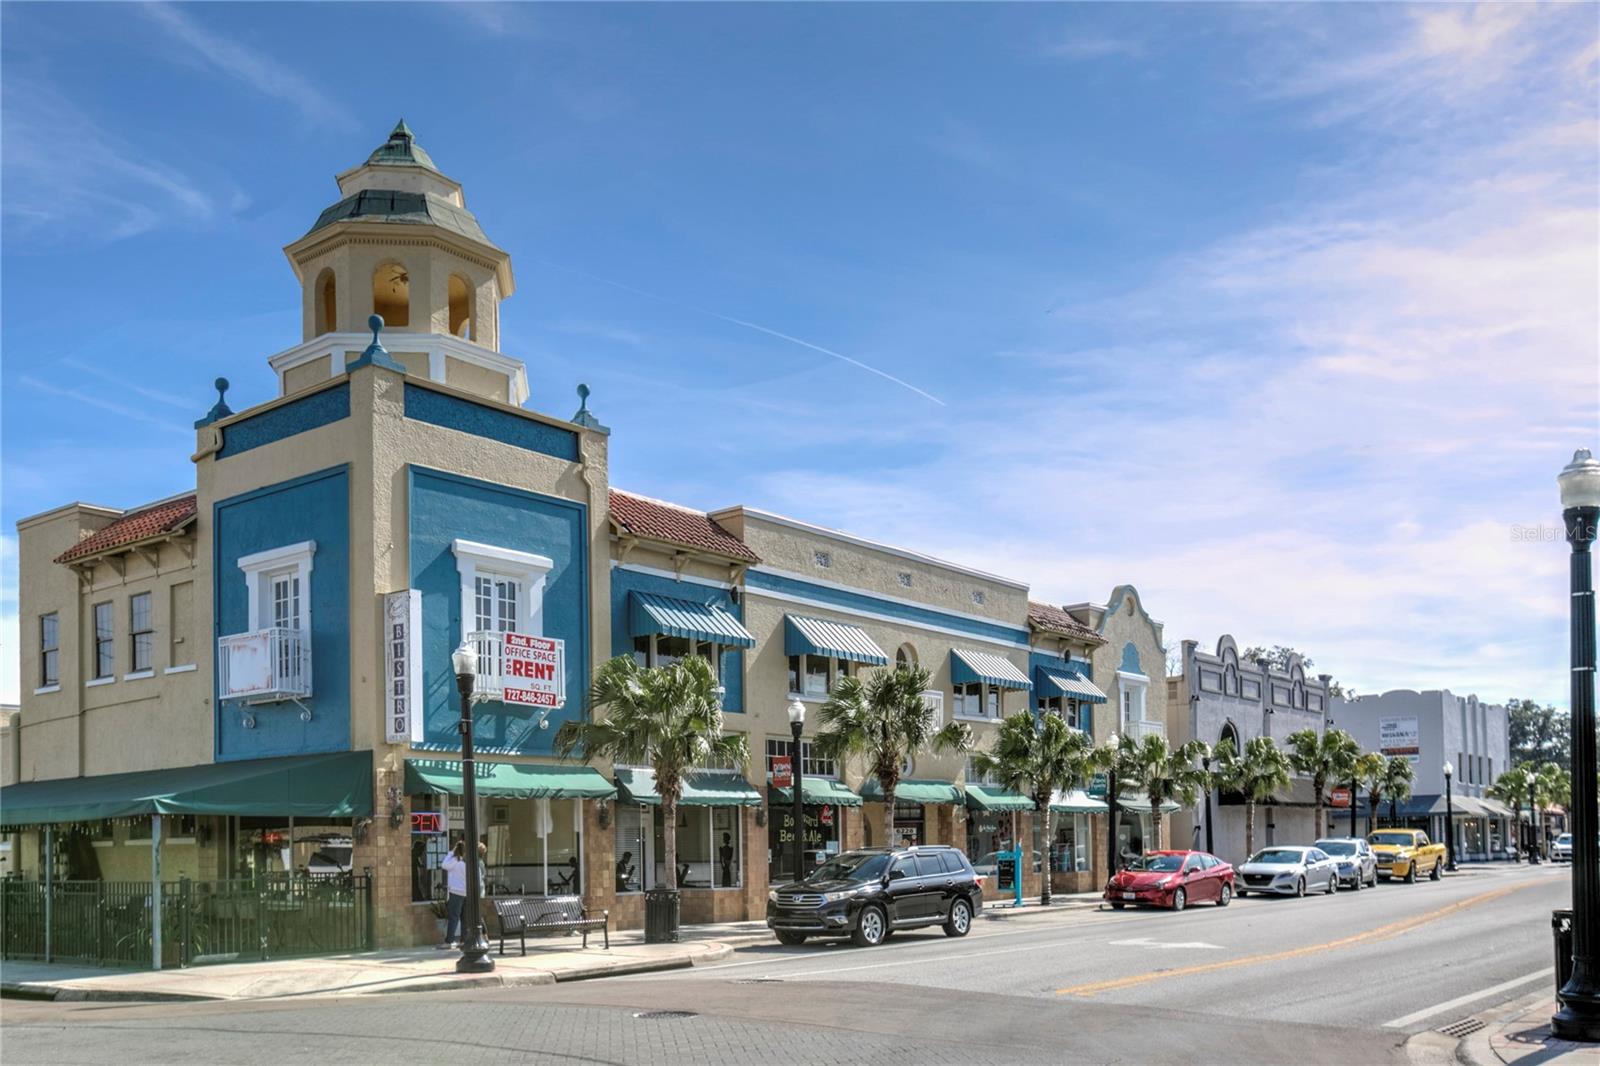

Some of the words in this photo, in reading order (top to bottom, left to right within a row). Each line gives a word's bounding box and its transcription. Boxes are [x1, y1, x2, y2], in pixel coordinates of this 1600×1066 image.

[510, 635, 528, 647] 2nd.
[530, 639, 551, 650] Floor
[504, 646, 530, 659] OFFICE
[533, 650, 556, 663] SPACE
[394, 624, 405, 733] BISTRO
[513, 659, 555, 681] RENT
[411, 814, 443, 832] PEN
[783, 814, 819, 827] Bovard
[809, 830, 822, 842] Ale
